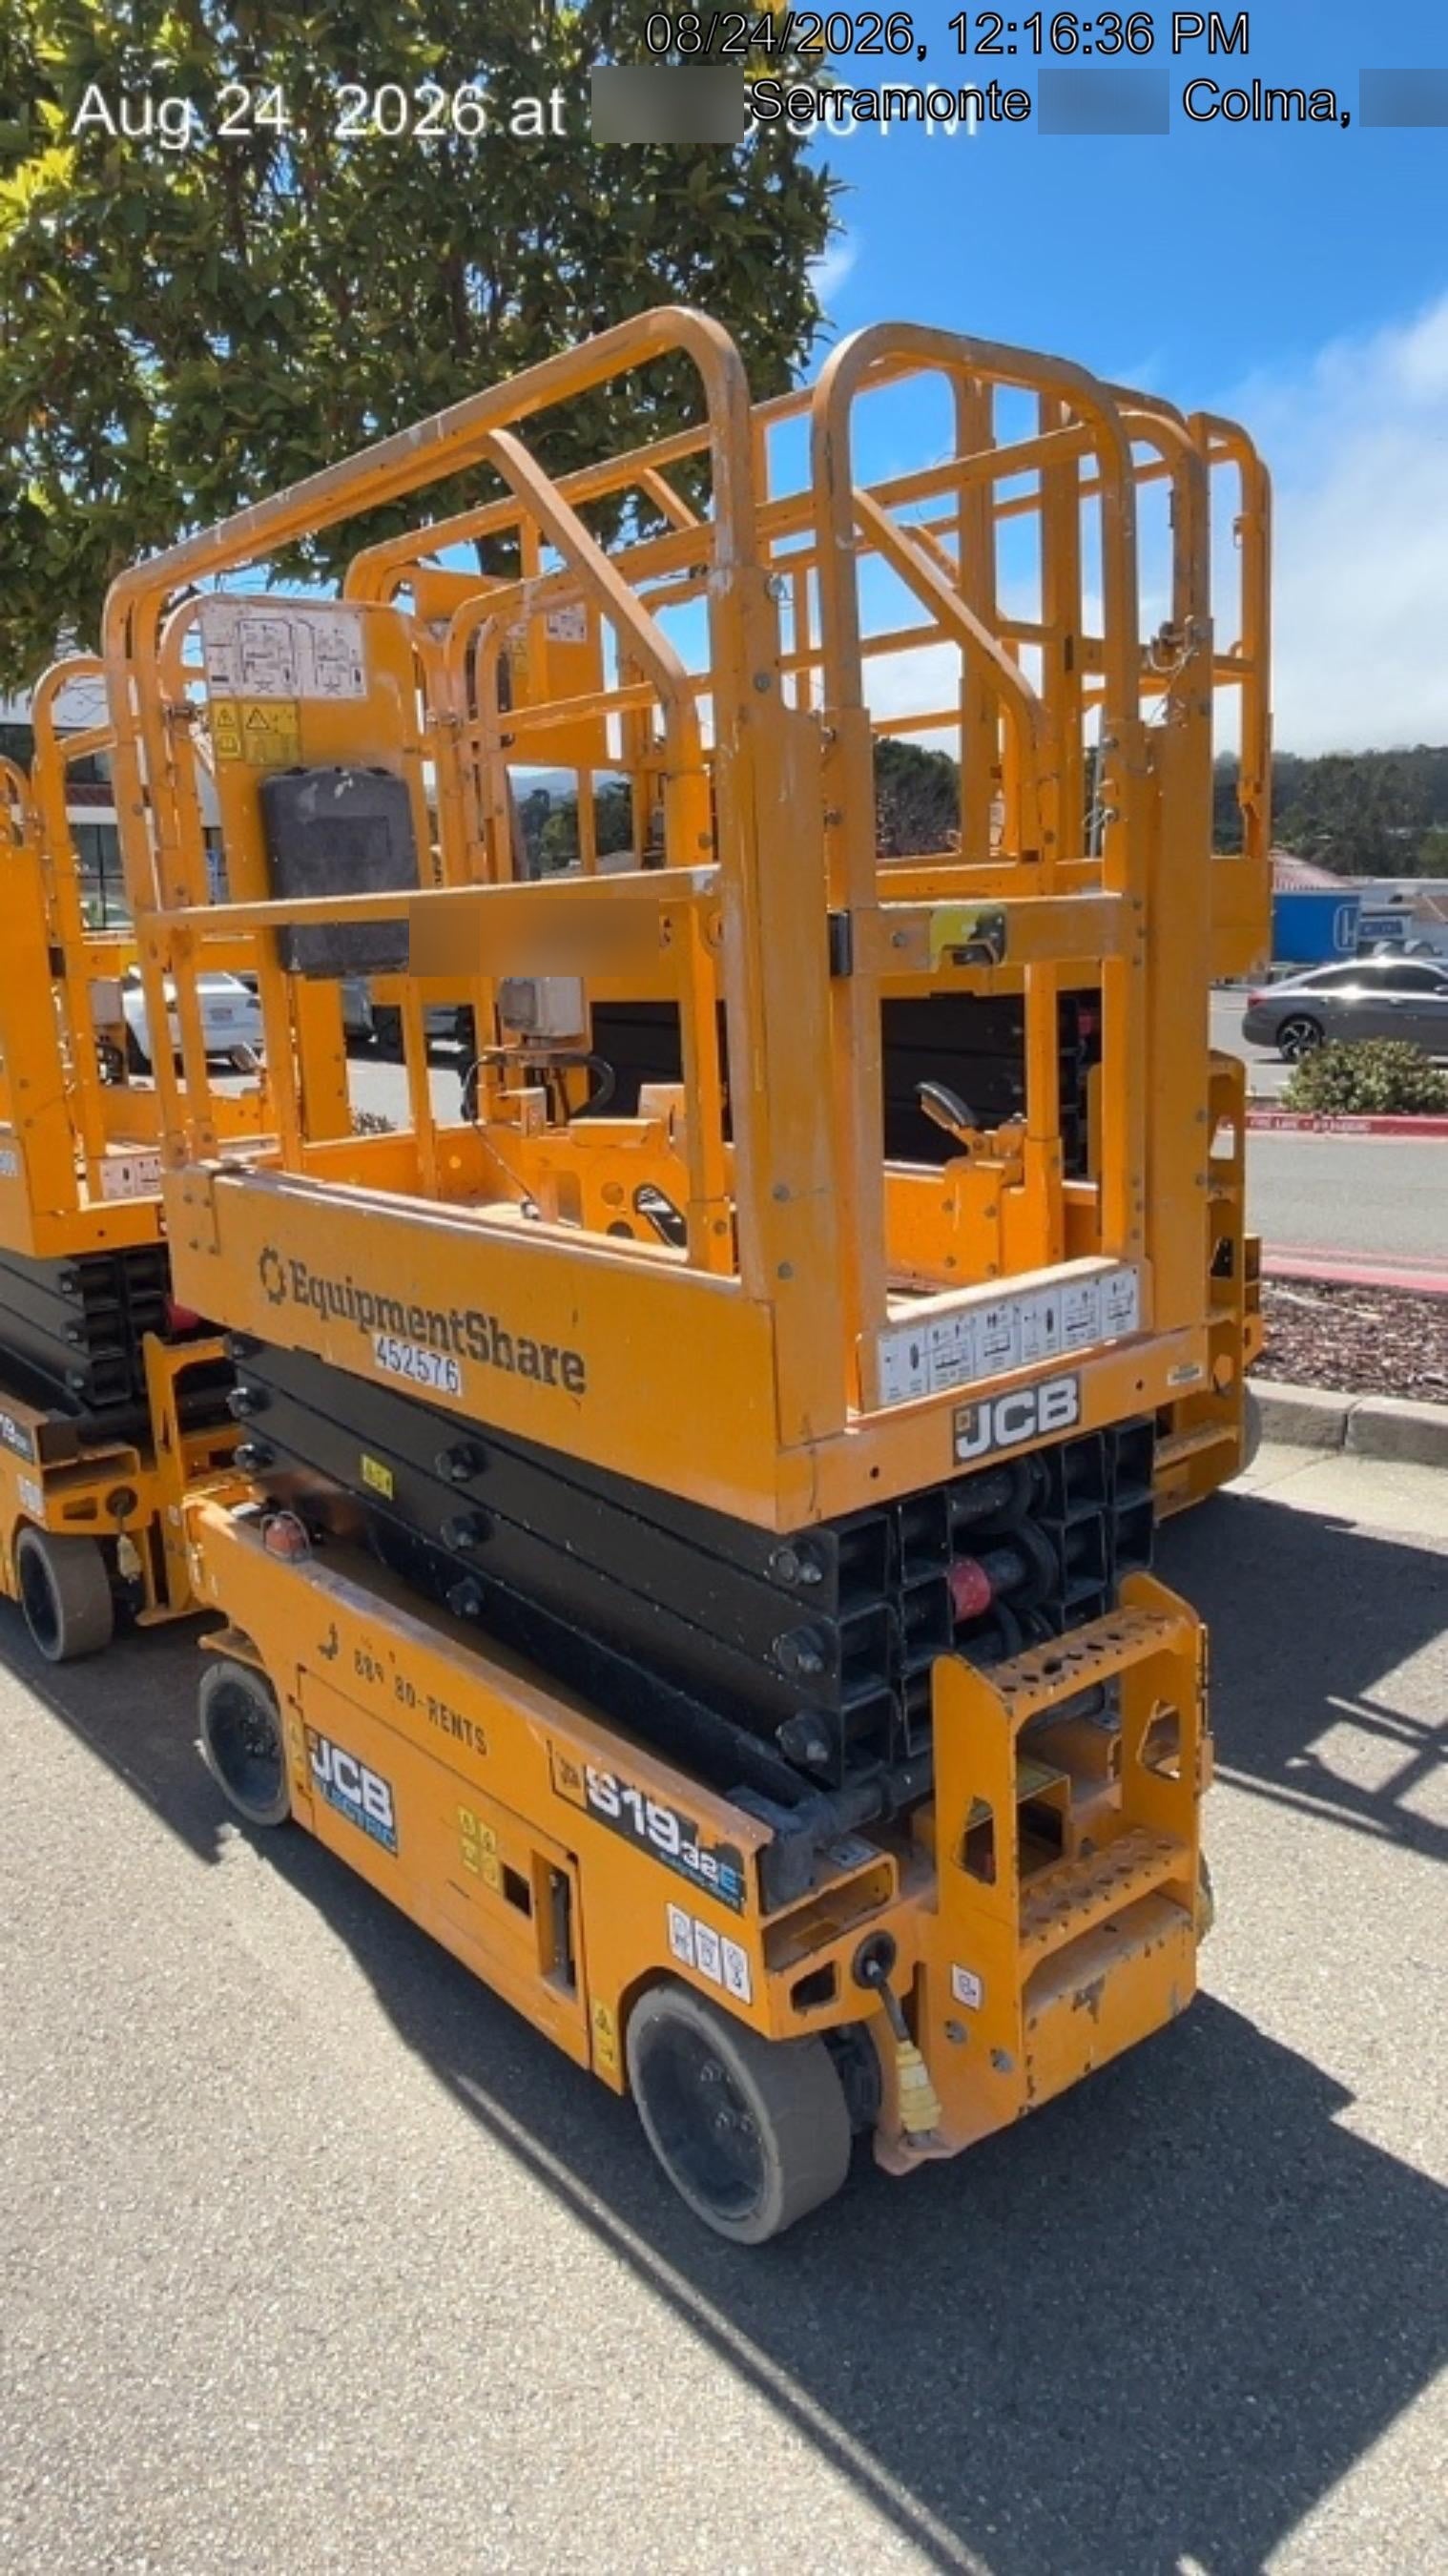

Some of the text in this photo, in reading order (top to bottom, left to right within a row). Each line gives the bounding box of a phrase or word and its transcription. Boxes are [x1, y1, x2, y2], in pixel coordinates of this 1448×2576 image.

[288, 1259, 587, 1395] EquipmentShare
[376, 1338, 460, 1394] 452576
[956, 1379, 1079, 1459] JCB
[311, 1739, 394, 1827] JCB
